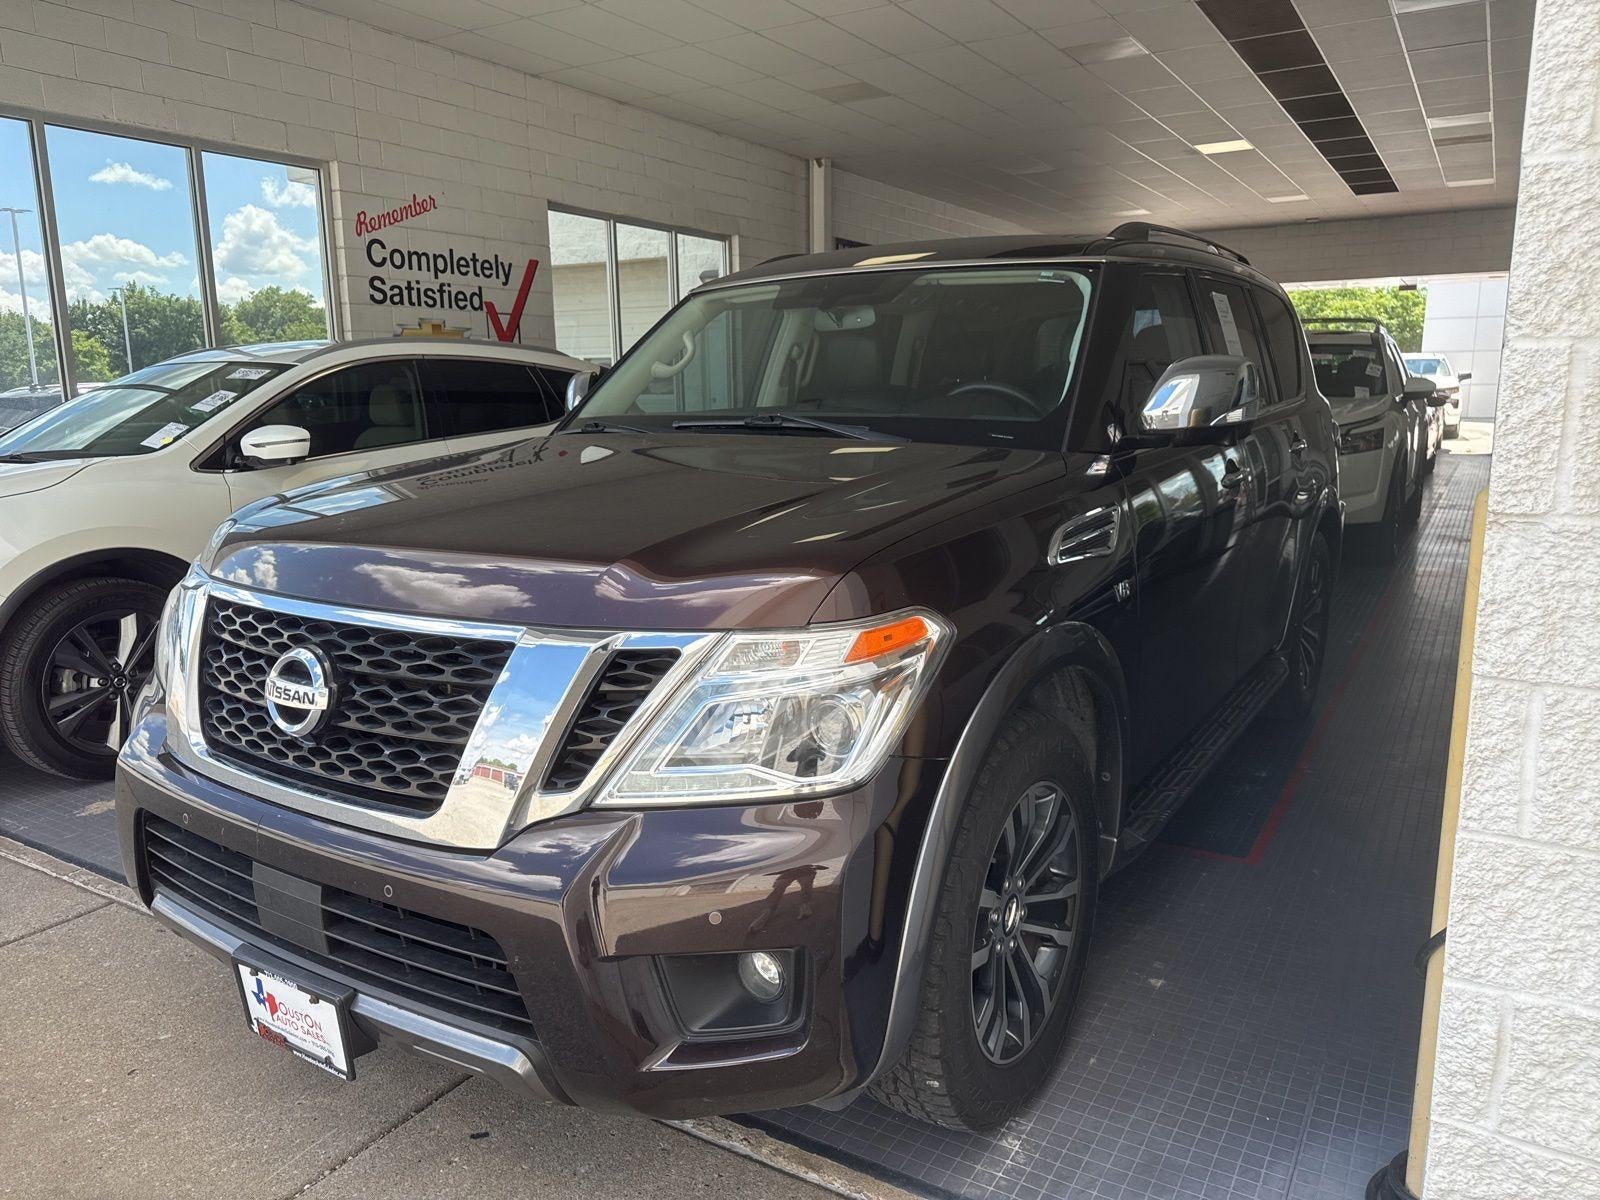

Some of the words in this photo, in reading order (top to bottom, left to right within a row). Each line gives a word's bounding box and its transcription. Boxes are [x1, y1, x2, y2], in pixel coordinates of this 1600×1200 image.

[355, 194, 438, 237] Remember
[366, 238, 513, 287] Completely
[368, 275, 484, 312] Satisfied
[266, 680, 316, 706] NISSAN
[276, 1014, 299, 1031] AUTO
[301, 1025, 326, 1043] SALES
